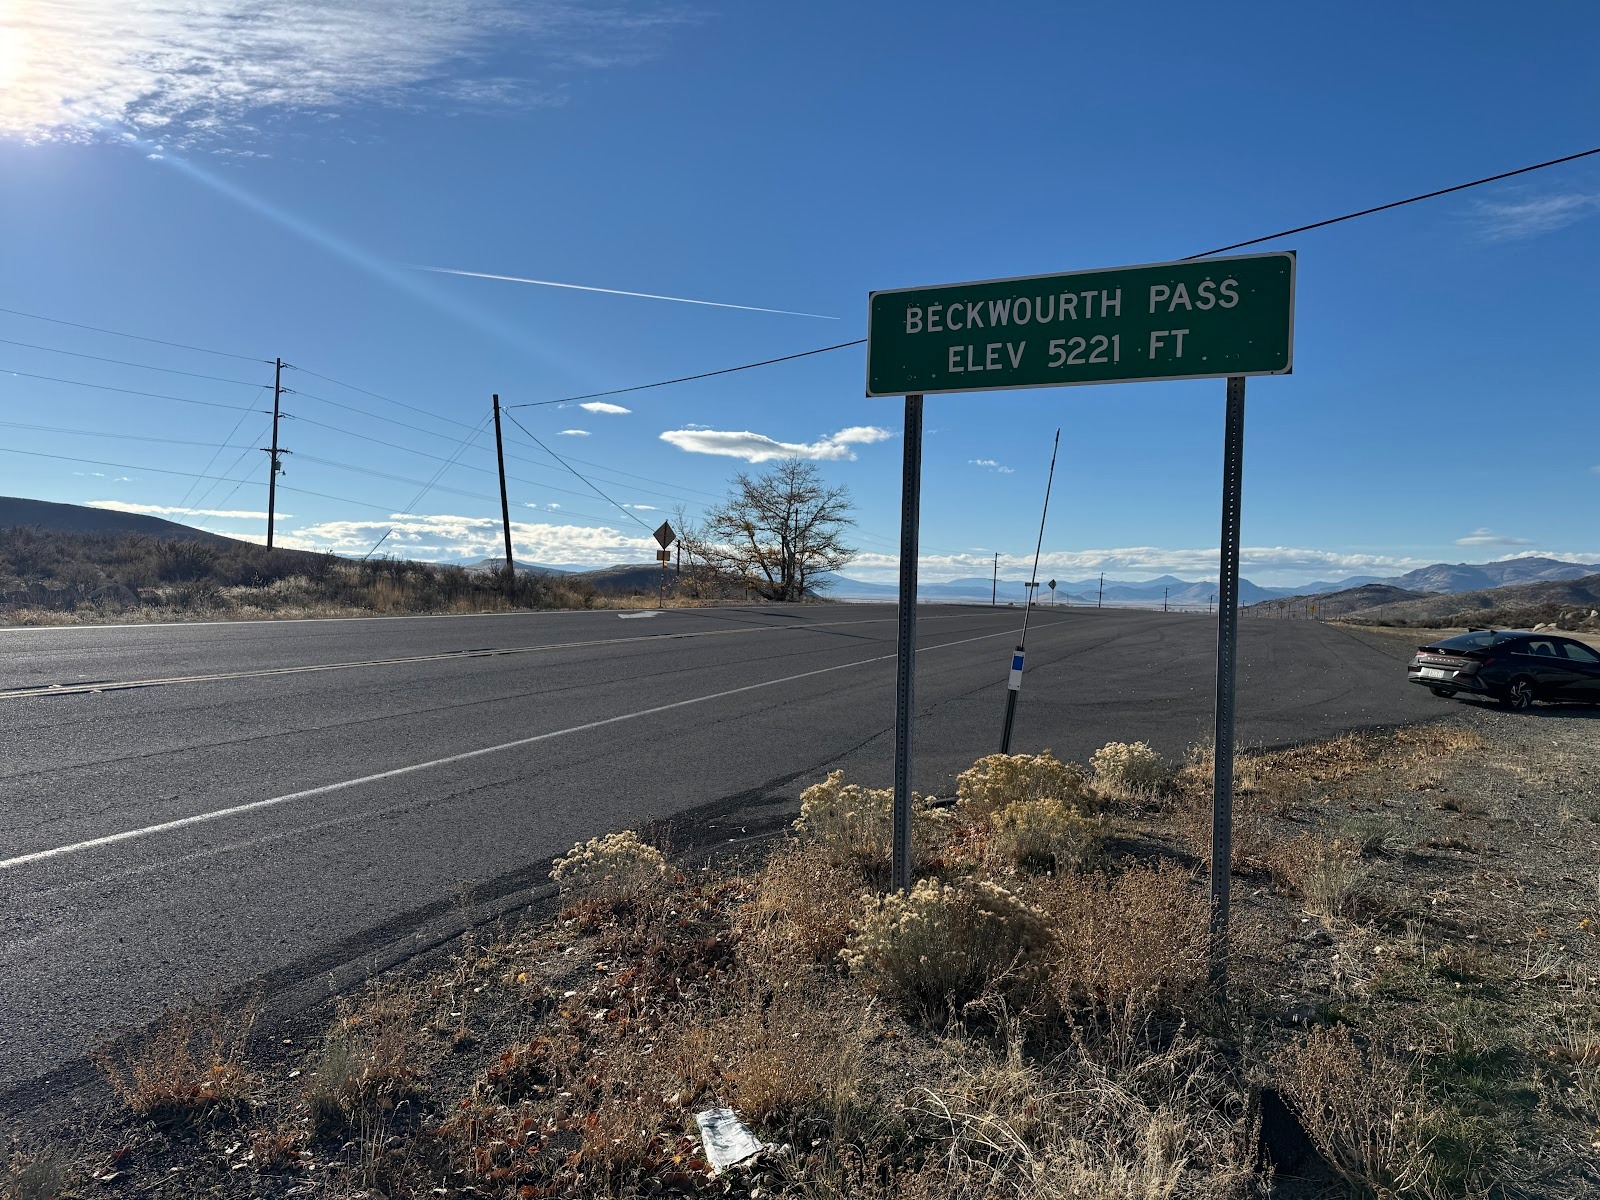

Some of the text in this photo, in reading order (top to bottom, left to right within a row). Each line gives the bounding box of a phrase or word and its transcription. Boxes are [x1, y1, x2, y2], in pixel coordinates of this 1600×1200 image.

[906, 279, 1240, 334] BECKWOURTH PASS
[948, 329, 1190, 373] ELEV 5221 FT
